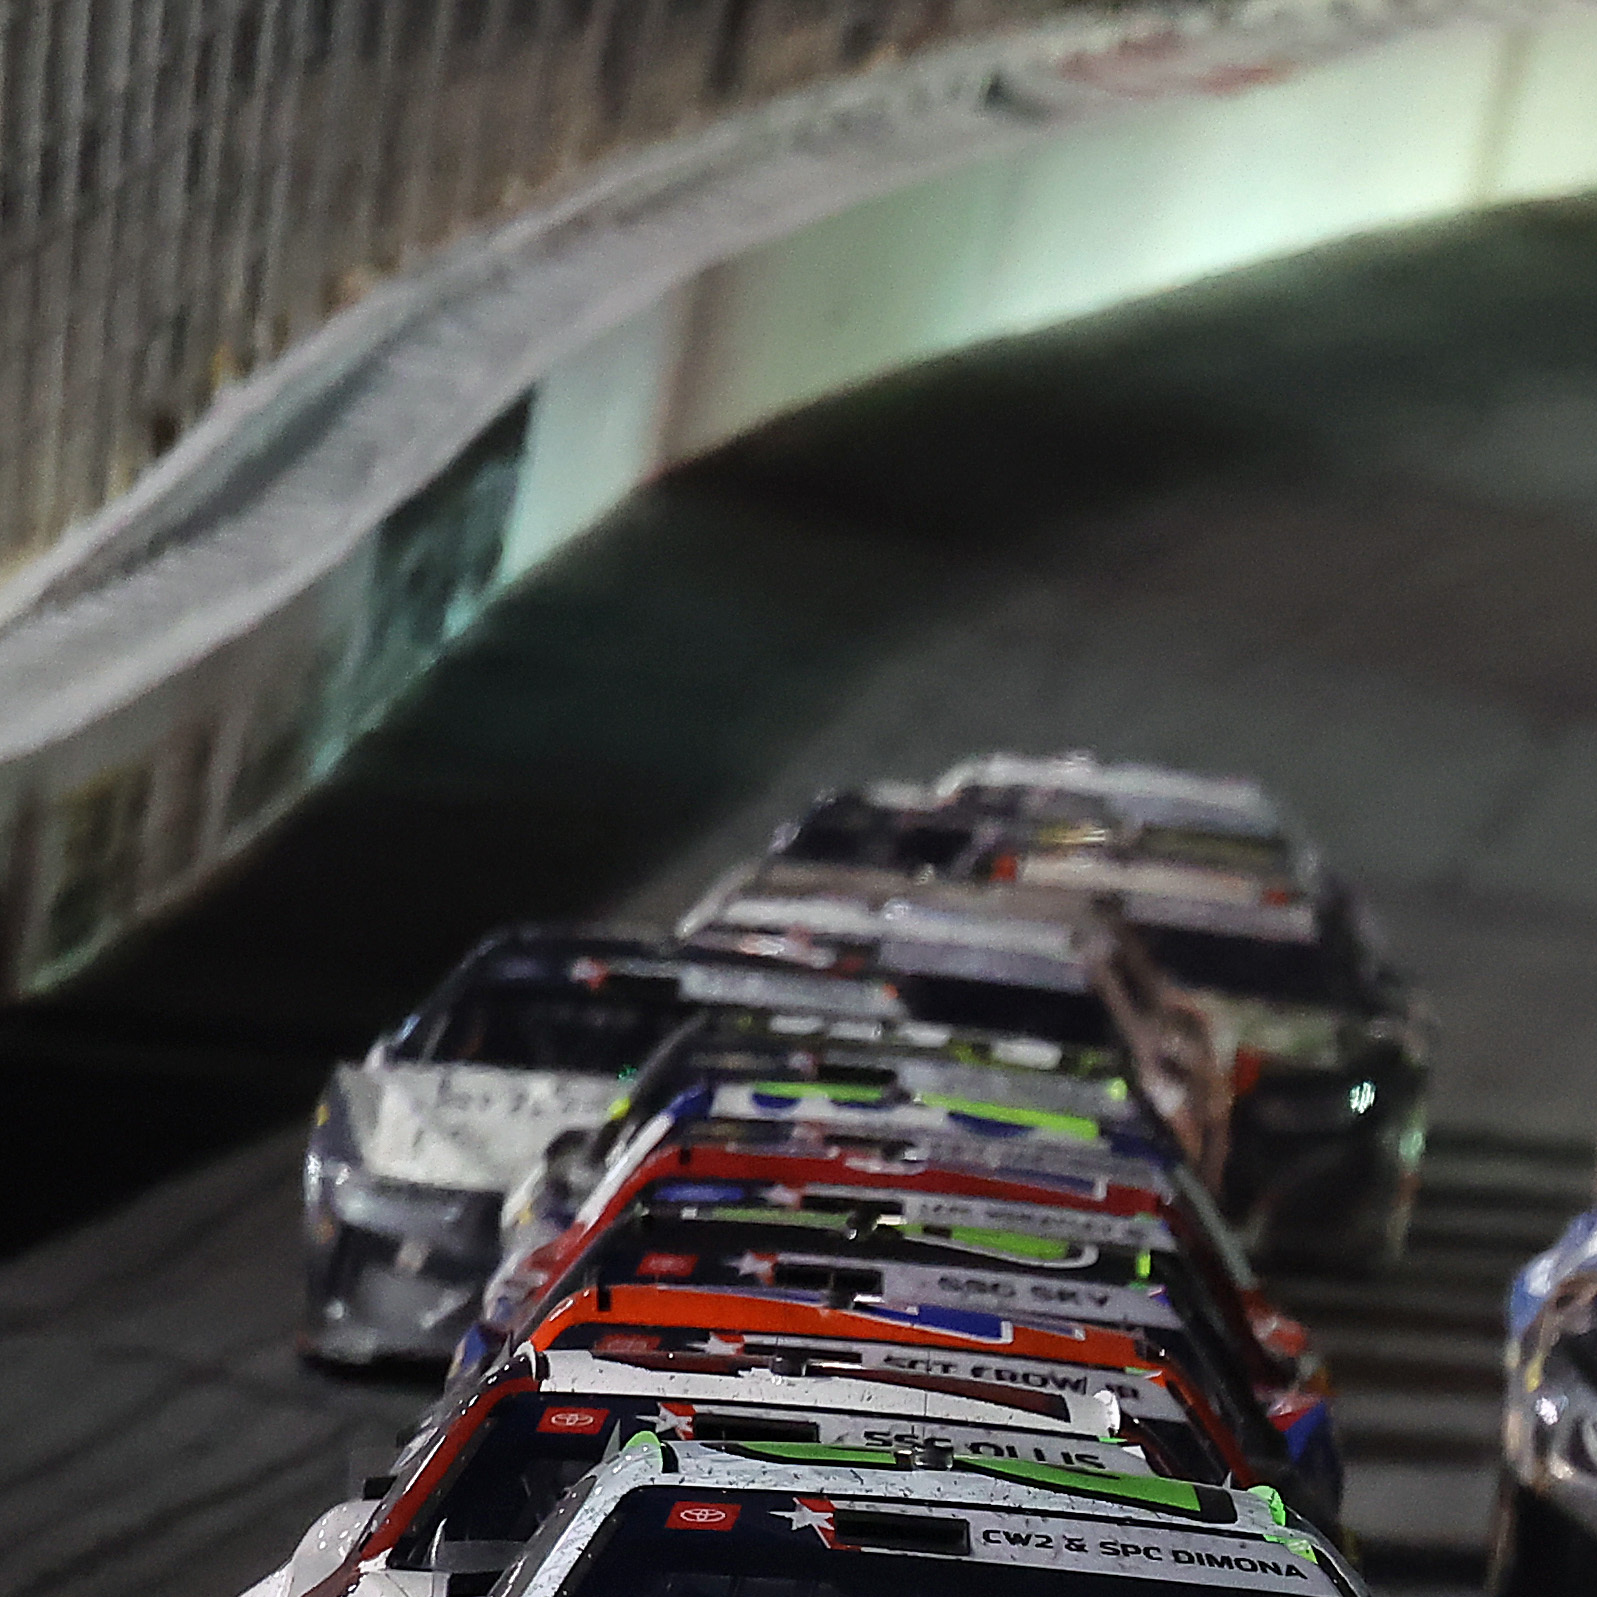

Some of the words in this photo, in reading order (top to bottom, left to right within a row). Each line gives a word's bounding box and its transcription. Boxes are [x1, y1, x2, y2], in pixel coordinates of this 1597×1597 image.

[980, 1527, 1055, 1551] CW2
[1098, 1539, 1165, 1562] SPC
[1172, 1548, 1309, 1582] DIMONA
